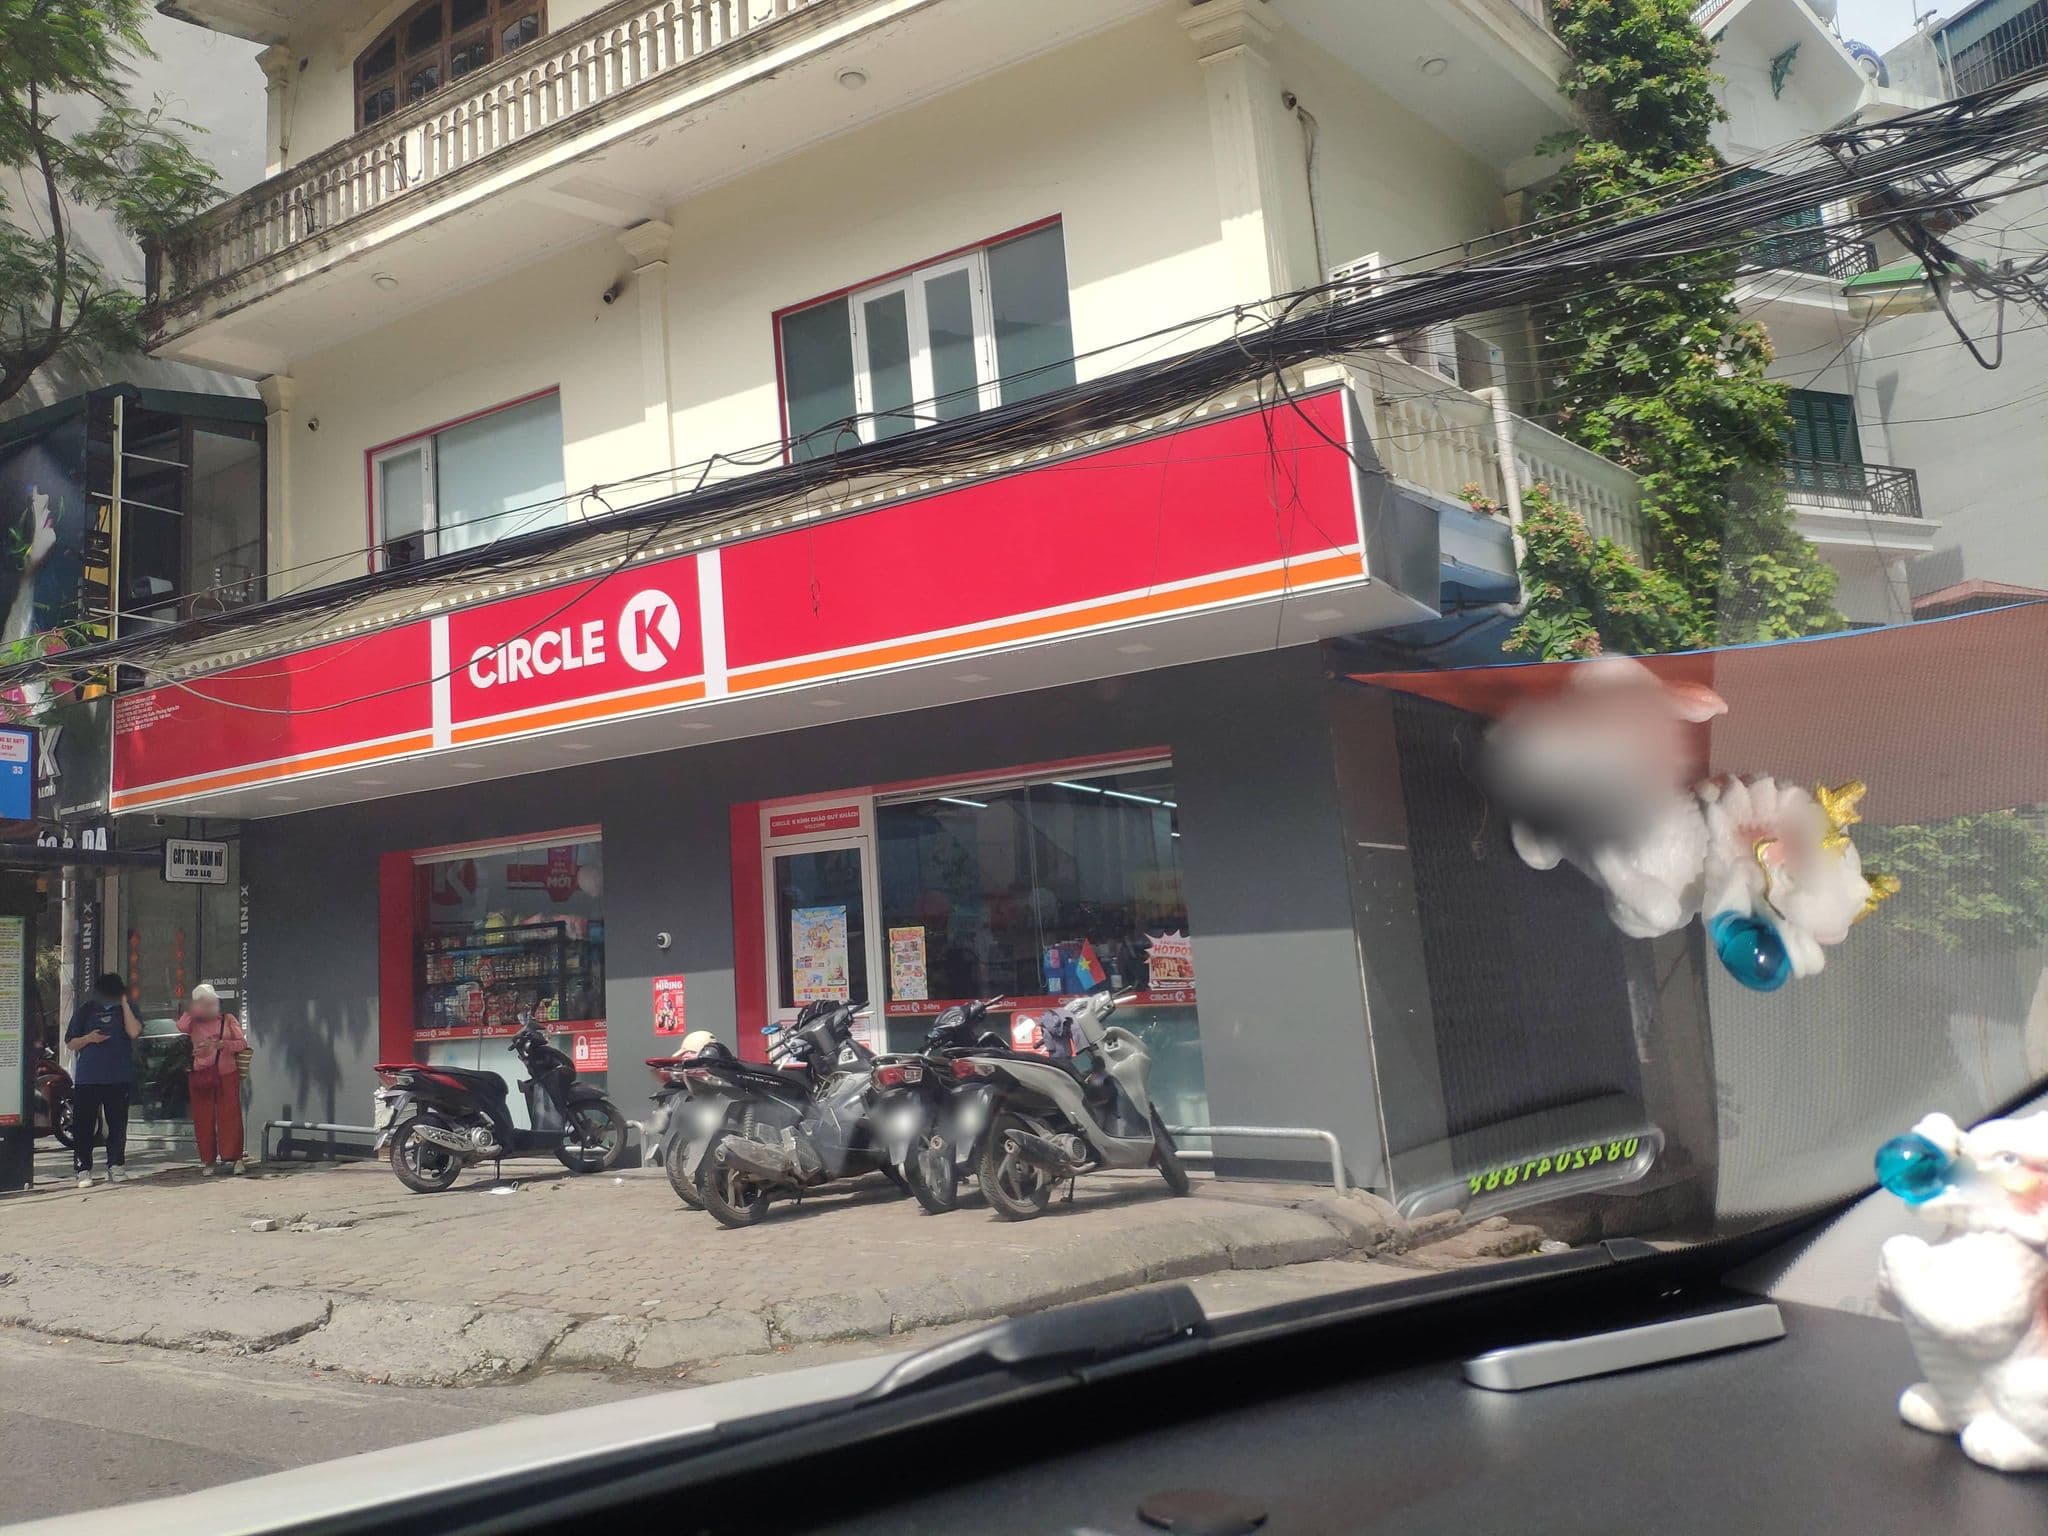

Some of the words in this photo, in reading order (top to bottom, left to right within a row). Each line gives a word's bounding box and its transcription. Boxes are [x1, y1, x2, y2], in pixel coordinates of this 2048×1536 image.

[469, 619, 606, 689] CIRCLE
[622, 593, 681, 670] K
[12, 766, 24, 775] 33
[655, 980, 683, 990] HIRING
[1150, 993, 1174, 1001] CIRCLE
[1174, 991, 1186, 1002] K
[890, 1003, 911, 1011] CIRCLE
